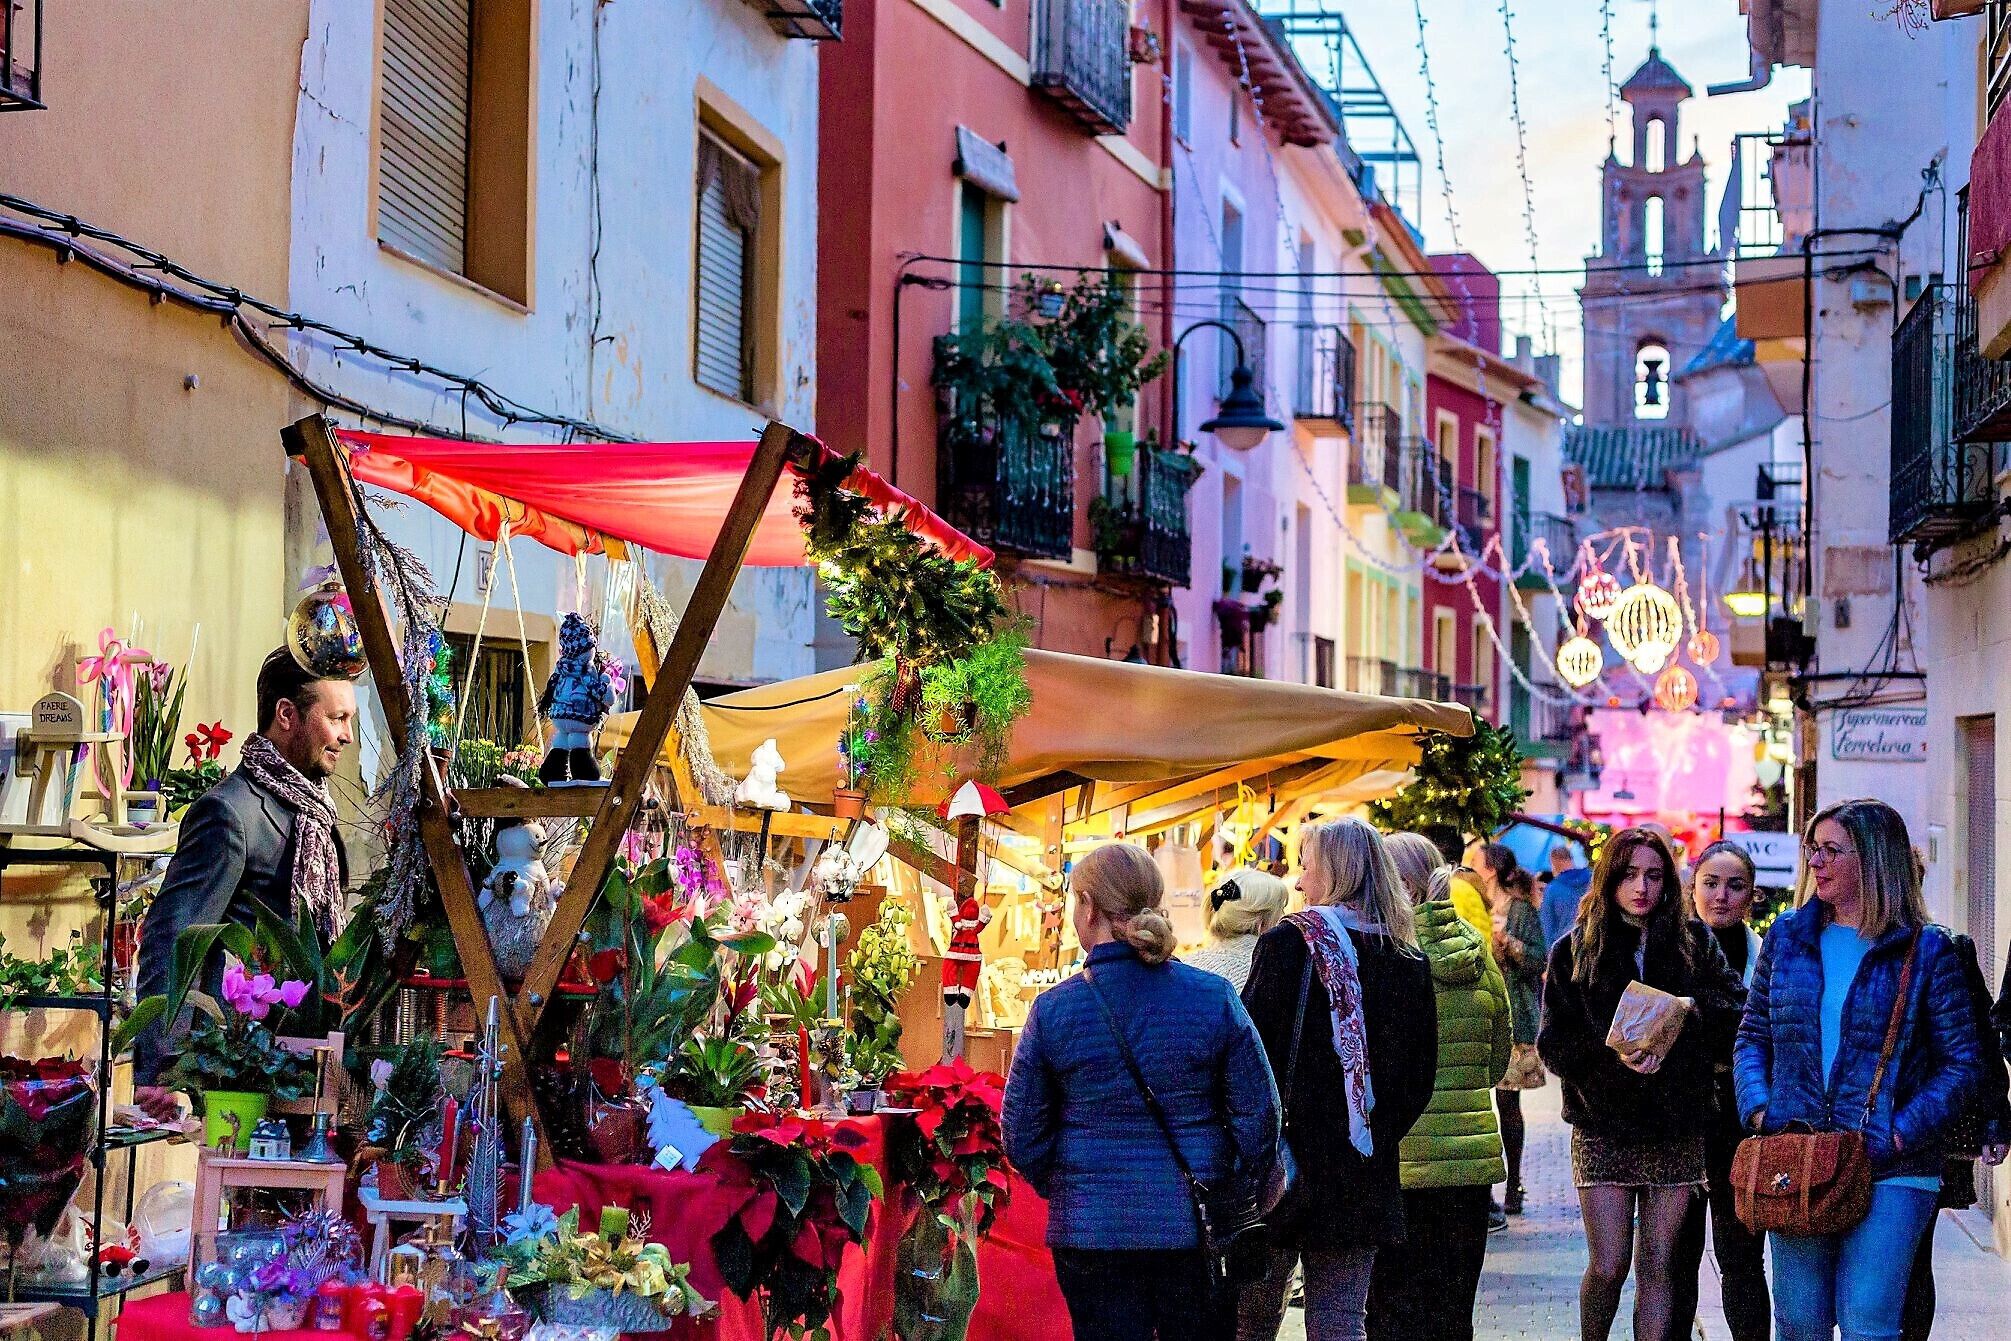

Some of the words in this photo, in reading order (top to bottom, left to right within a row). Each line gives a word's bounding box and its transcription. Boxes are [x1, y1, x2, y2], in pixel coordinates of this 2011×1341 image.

[41, 701, 68, 711] FAERIE
[40, 712, 73, 722] DREAMS
[1746, 840, 1778, 856] WC
